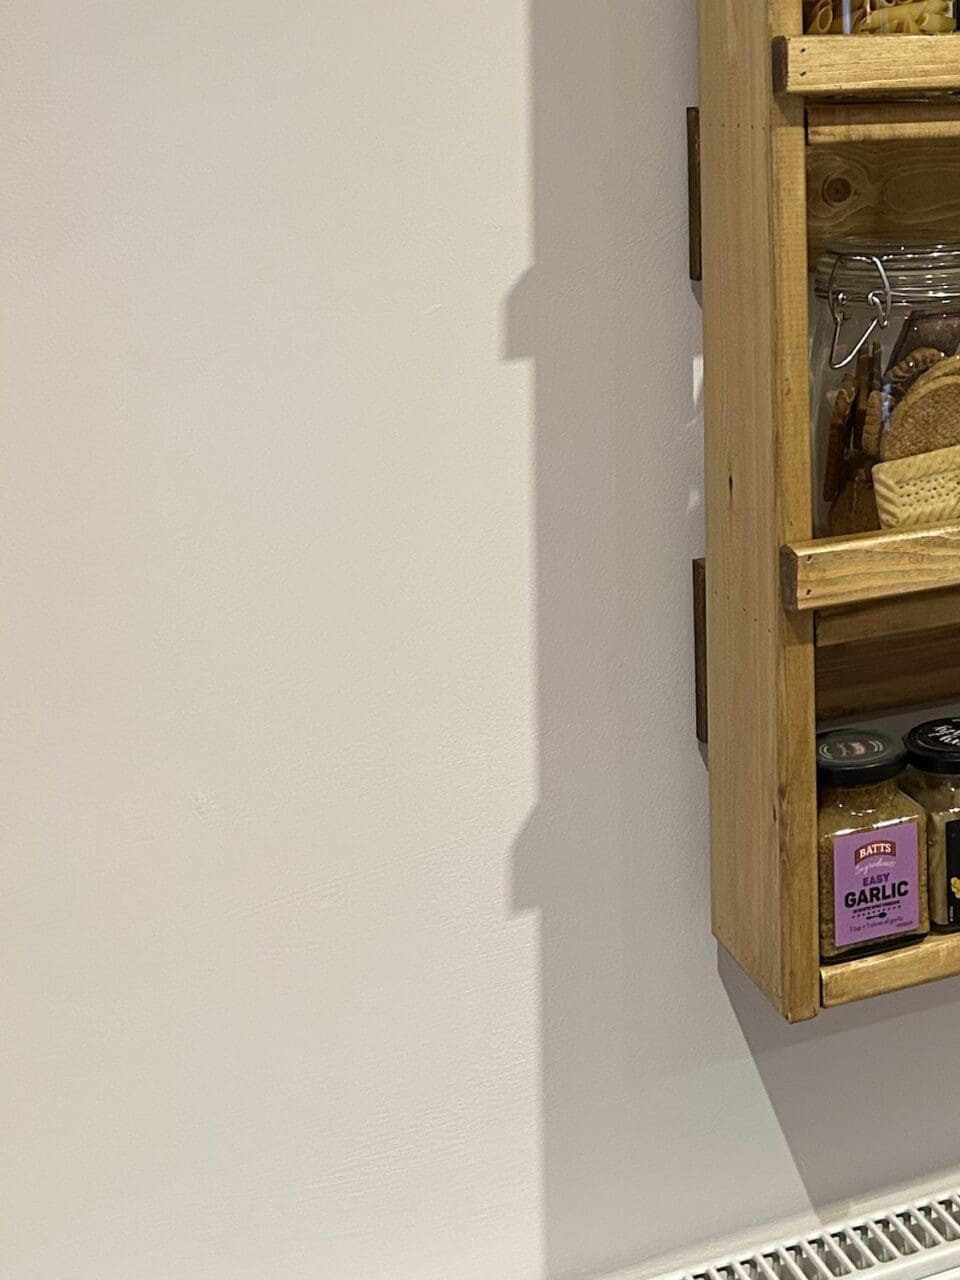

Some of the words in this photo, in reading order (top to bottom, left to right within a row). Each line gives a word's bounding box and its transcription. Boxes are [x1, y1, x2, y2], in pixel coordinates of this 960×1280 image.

[859, 843, 892, 859] BATTS
[863, 872, 890, 887] EASY
[844, 880, 909, 908] GARLIC
